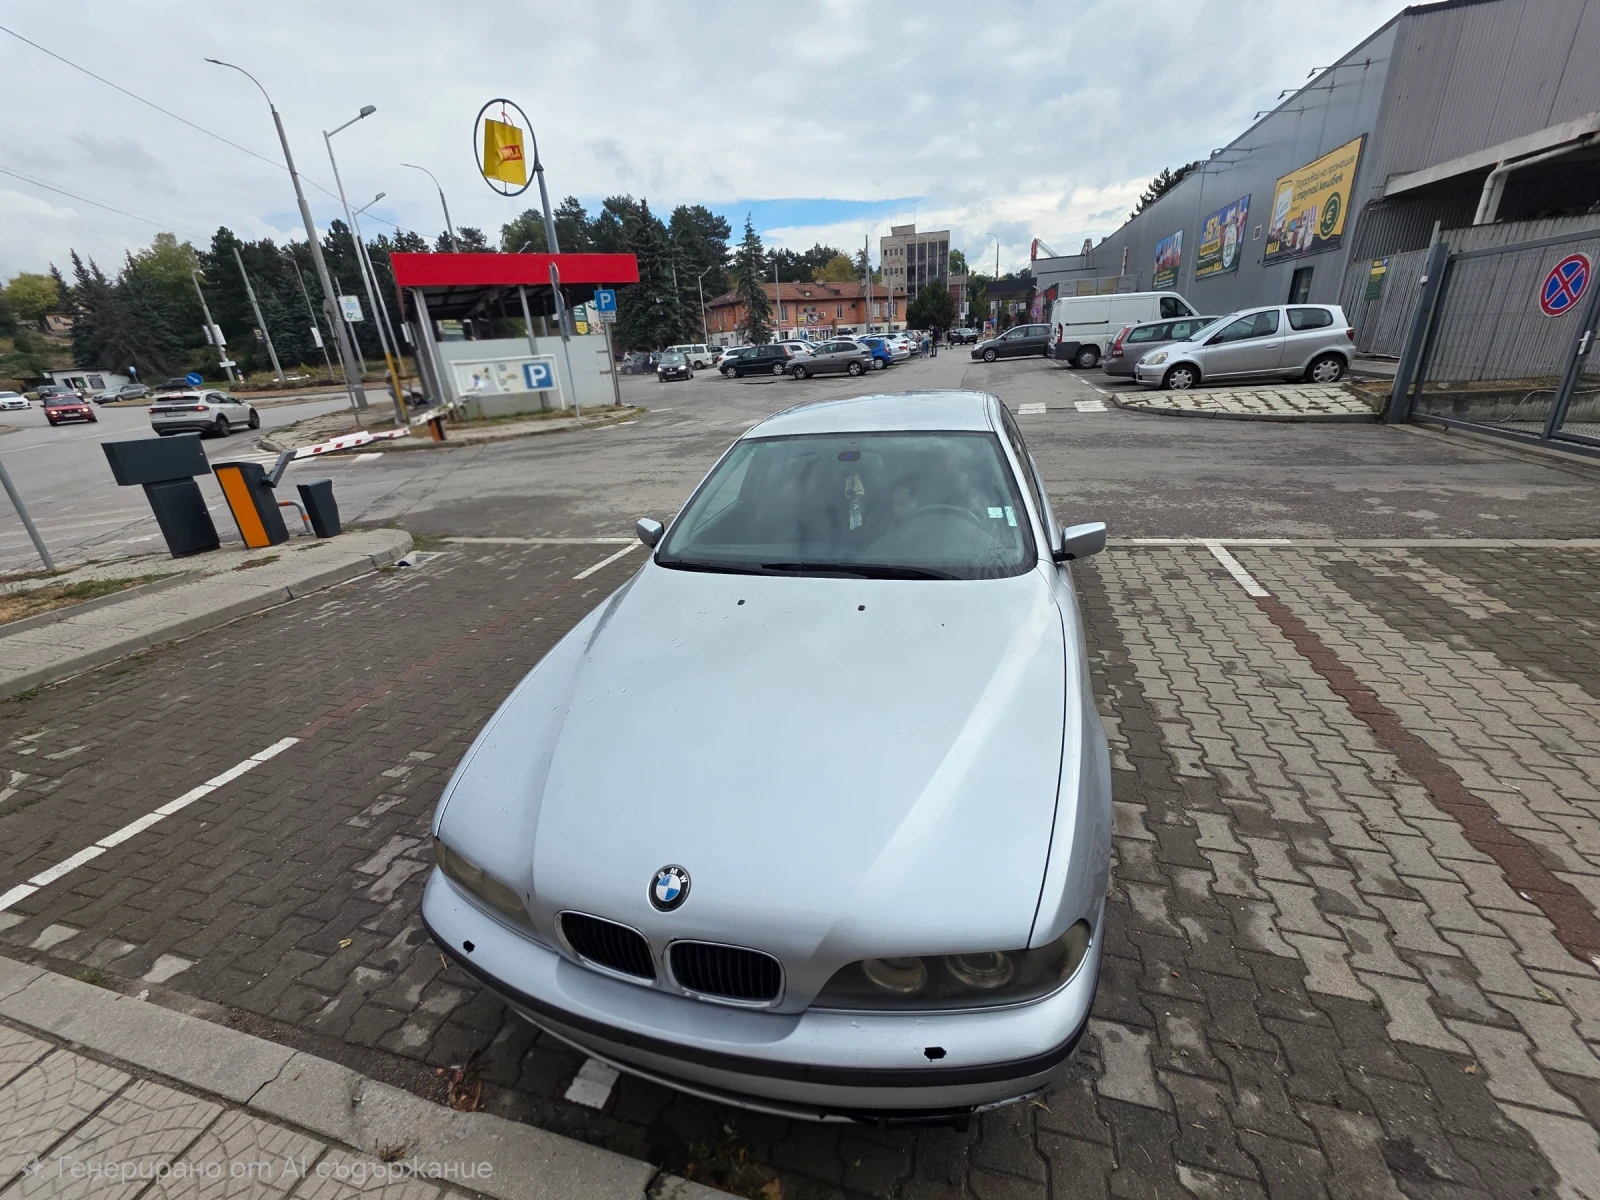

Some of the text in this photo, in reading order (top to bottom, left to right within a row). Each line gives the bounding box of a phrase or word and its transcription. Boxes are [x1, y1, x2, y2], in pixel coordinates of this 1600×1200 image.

[600, 293, 611, 309] P
[528, 365, 547, 387] P
[658, 868, 688, 883] BMW
